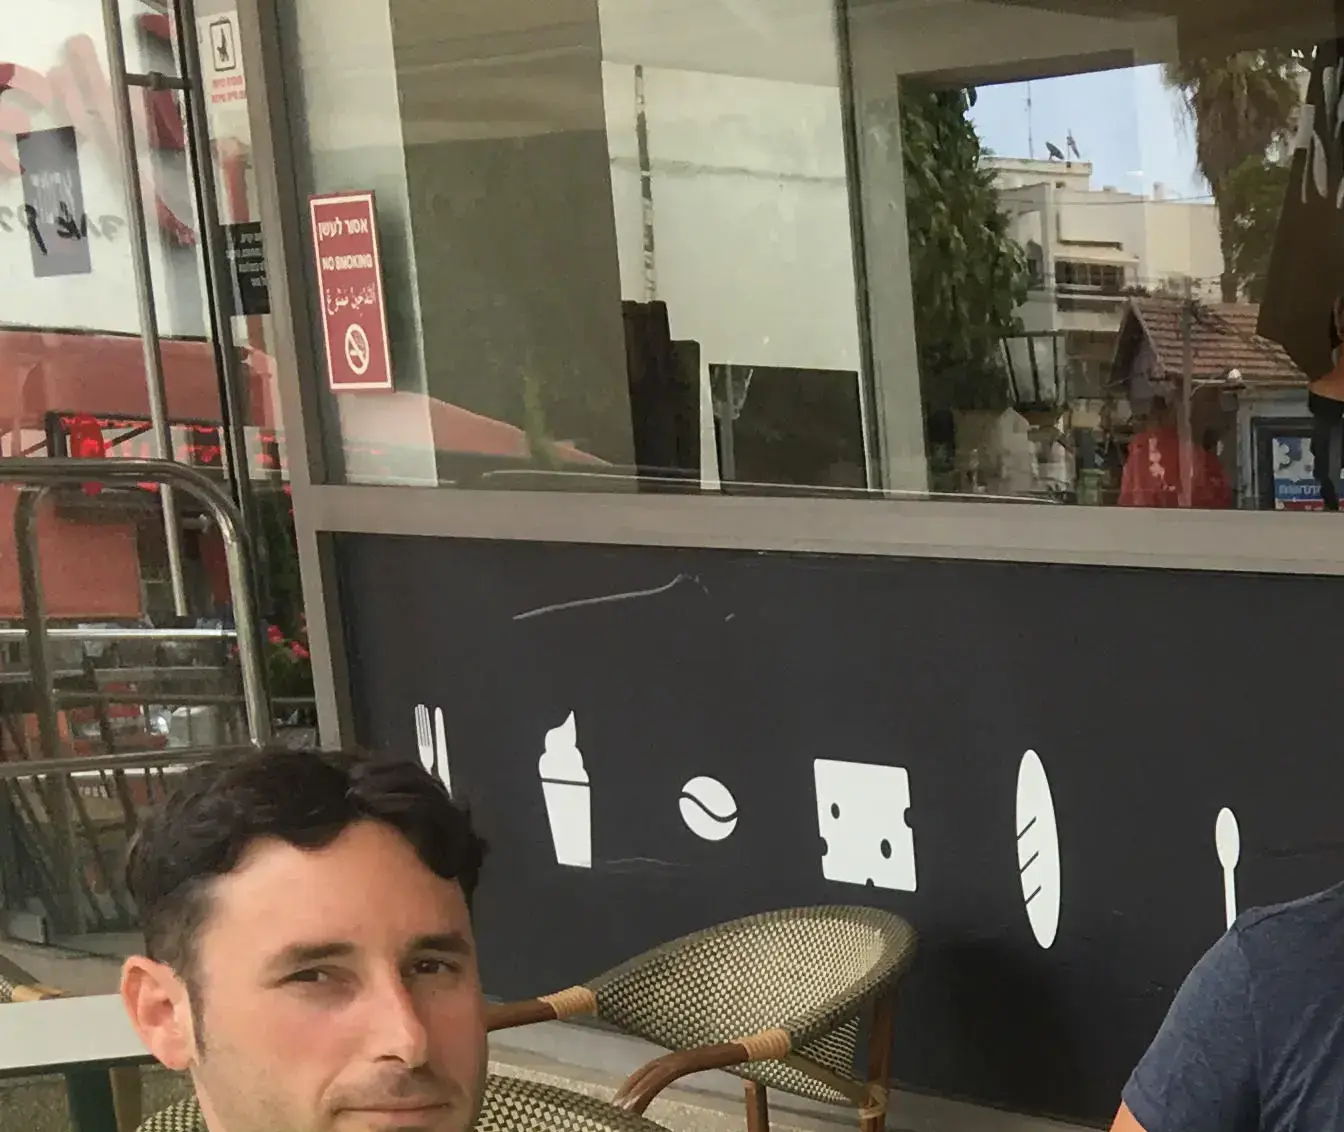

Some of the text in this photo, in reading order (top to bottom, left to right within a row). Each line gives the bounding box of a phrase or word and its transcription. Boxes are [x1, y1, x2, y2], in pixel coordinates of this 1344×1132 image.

[318, 216, 343, 242] לעשן
[322, 253, 373, 271] NO SMOKING
